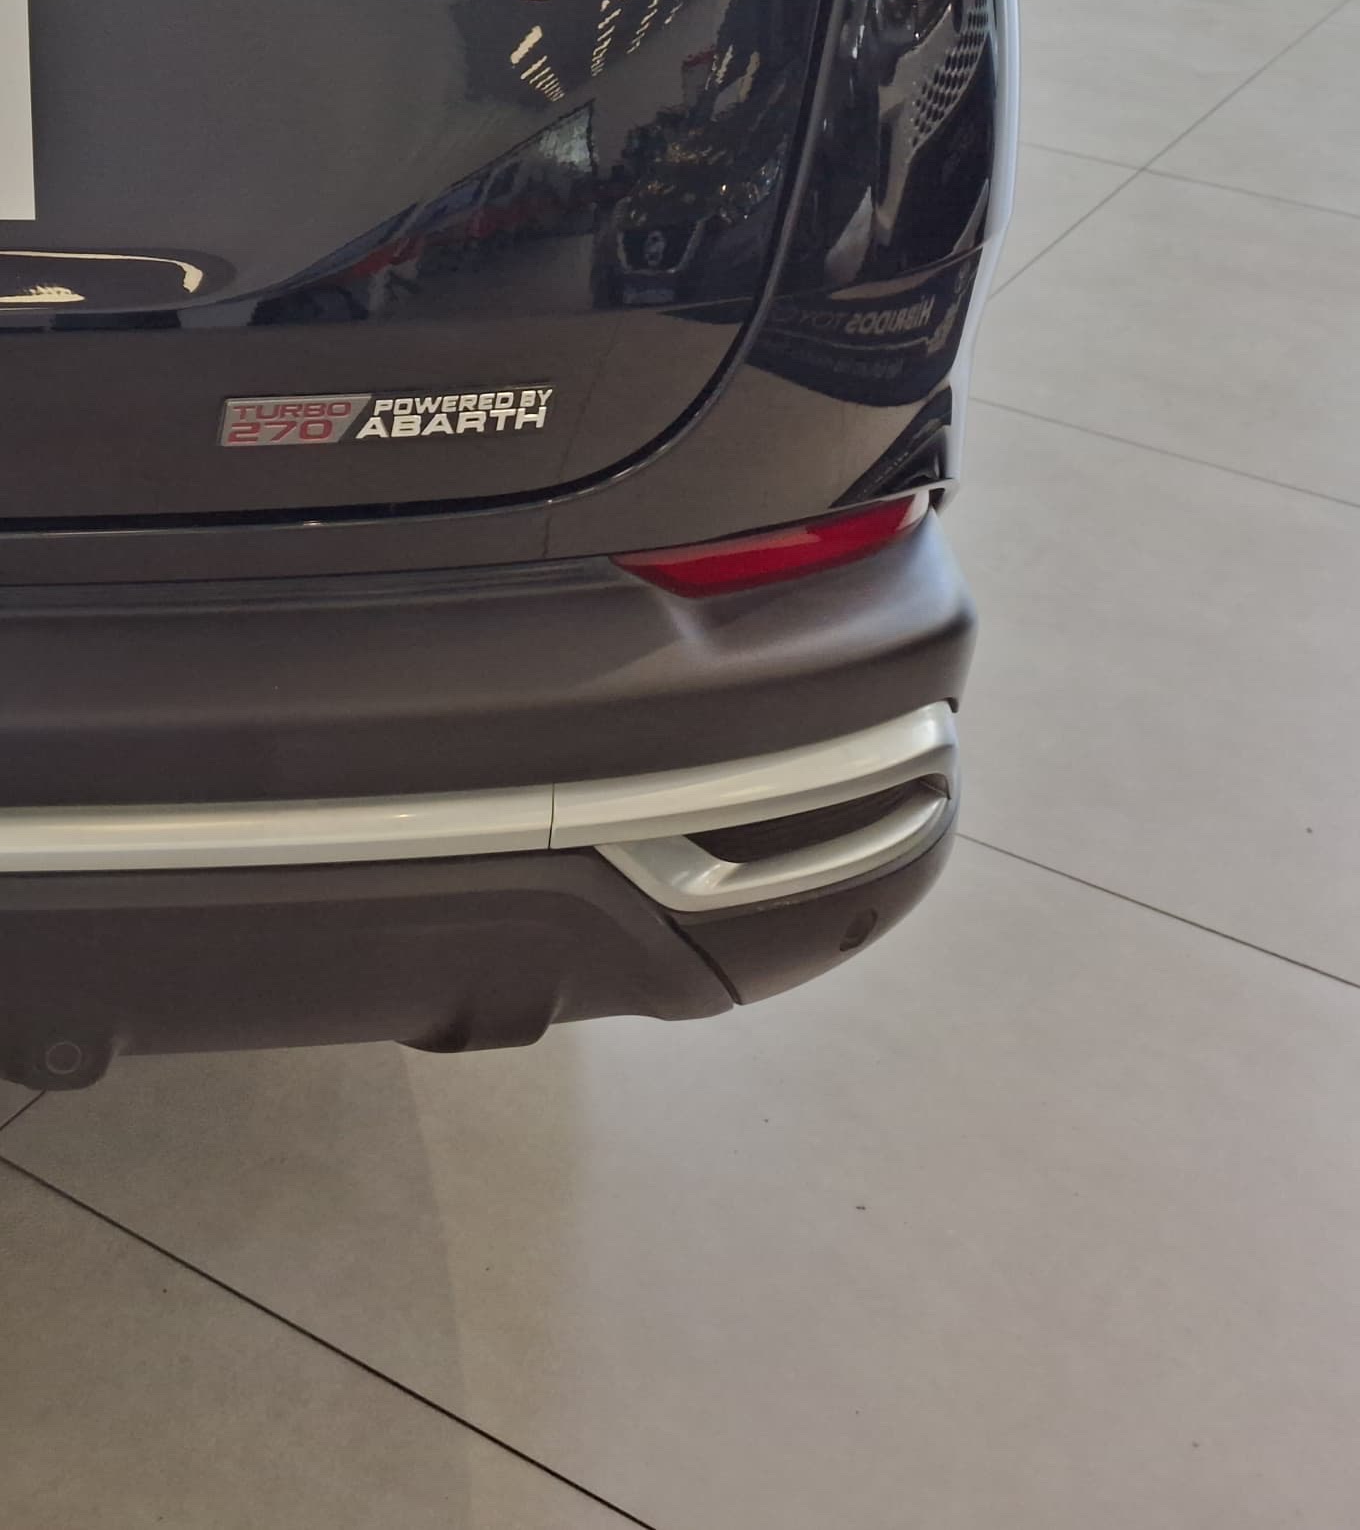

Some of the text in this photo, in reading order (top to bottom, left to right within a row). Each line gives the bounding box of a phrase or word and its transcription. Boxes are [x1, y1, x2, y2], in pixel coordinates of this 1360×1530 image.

[233, 401, 352, 421] TURBO
[373, 389, 554, 417] POWERED BY
[228, 420, 334, 444] 270
[355, 407, 548, 440] ABARTH
